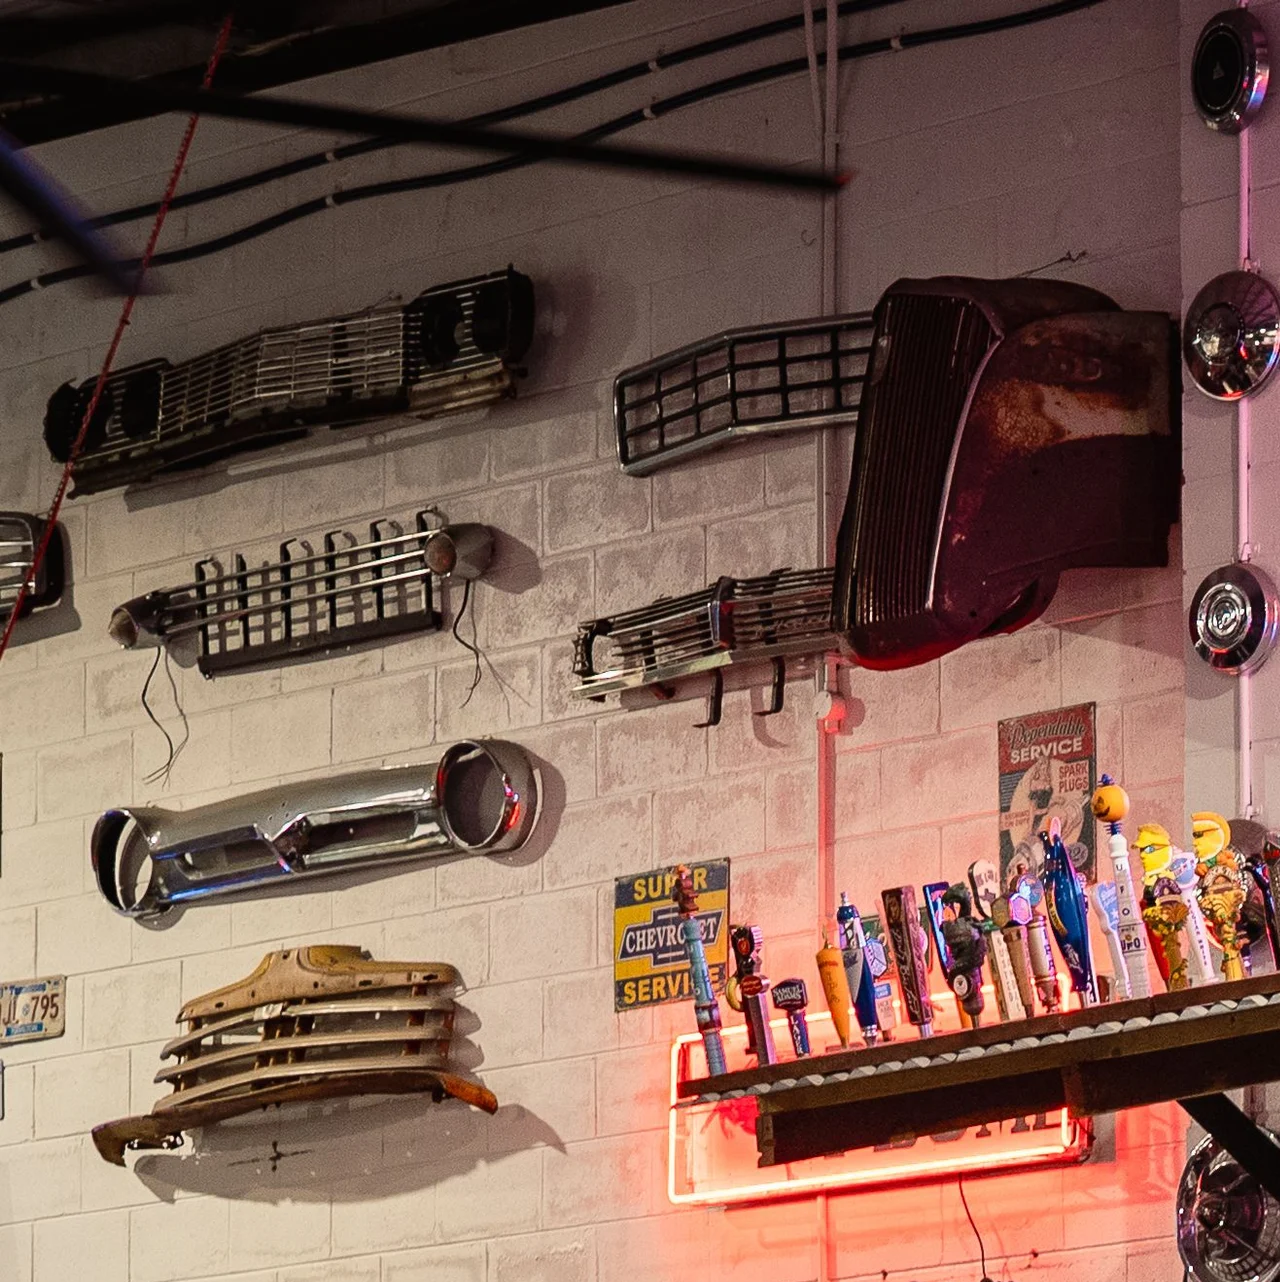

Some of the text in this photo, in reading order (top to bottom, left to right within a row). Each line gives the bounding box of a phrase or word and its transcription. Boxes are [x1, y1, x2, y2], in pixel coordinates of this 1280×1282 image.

[1008, 715, 1087, 750] Dependable
[1010, 737, 1083, 765] SERVICE
[1058, 762, 1089, 780] SPARK
[1058, 778, 1089, 794] PLUGS
[633, 868, 708, 901] SUPR
[625, 916, 718, 954] CHEVROET
[624, 966, 720, 1005] SERVIE
[31, 993, 60, 1022] 795
